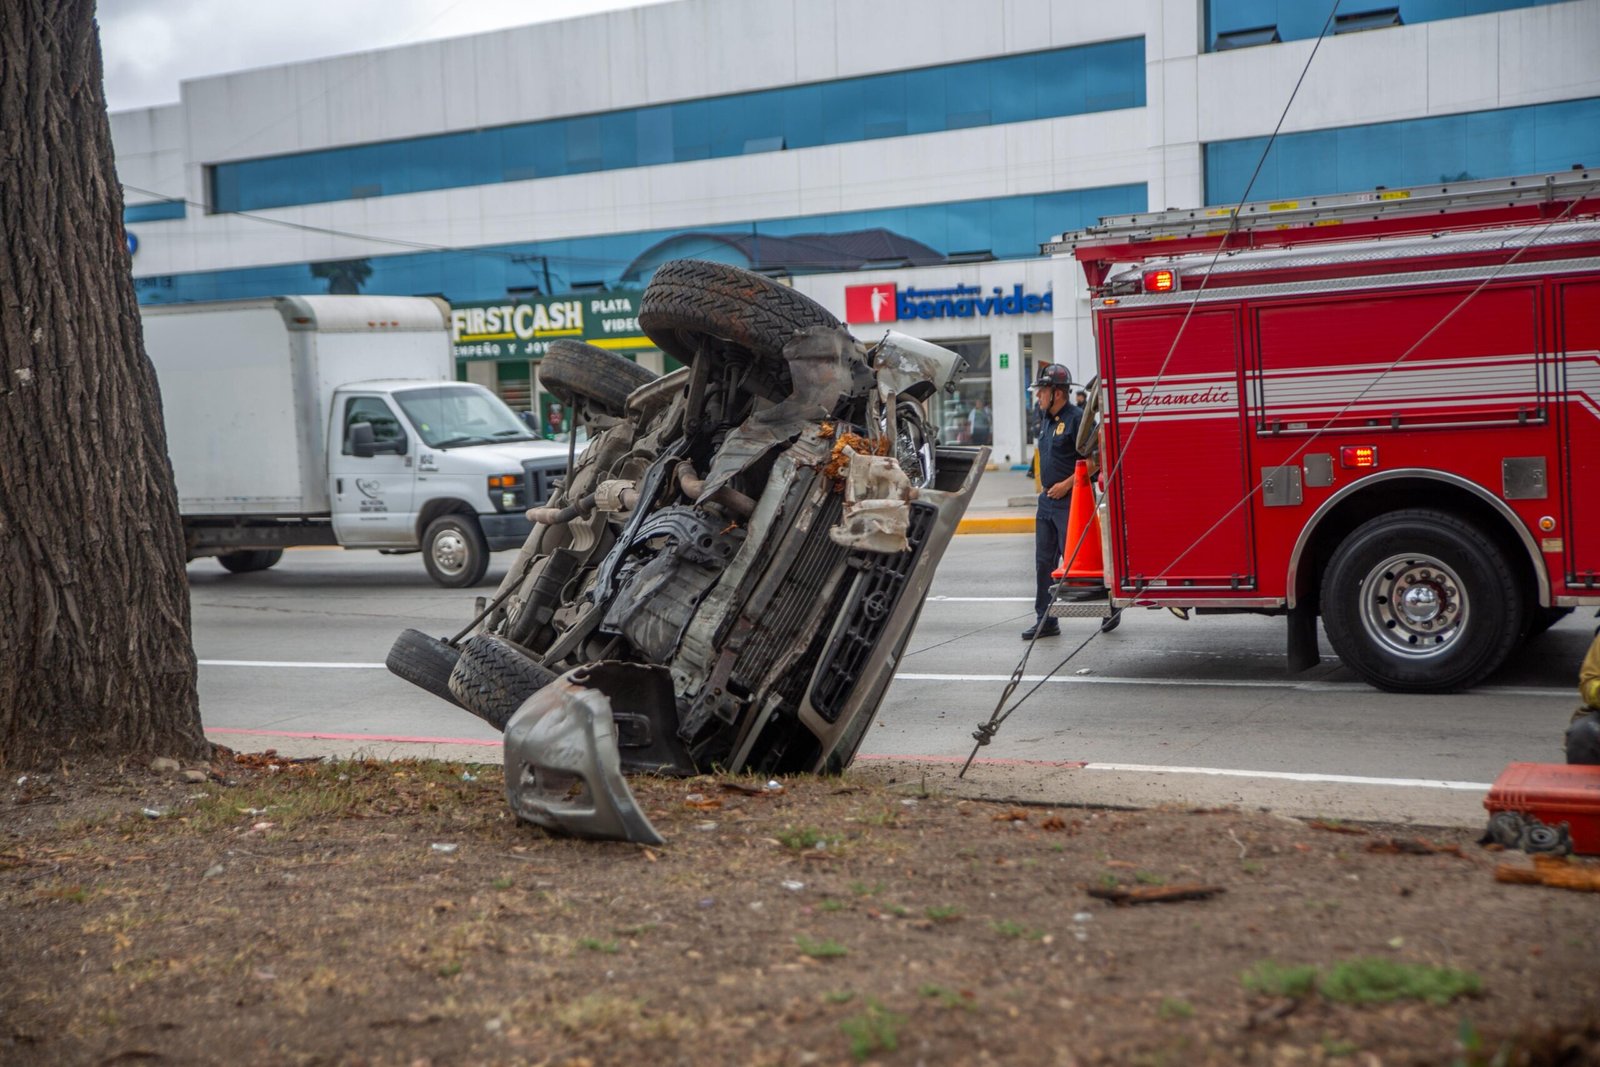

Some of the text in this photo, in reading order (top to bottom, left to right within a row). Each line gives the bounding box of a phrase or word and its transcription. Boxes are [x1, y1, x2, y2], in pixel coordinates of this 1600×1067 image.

[591, 298, 632, 314] PLATA
[507, 343, 517, 355] Y
[1124, 386, 1230, 411] Paramedic
